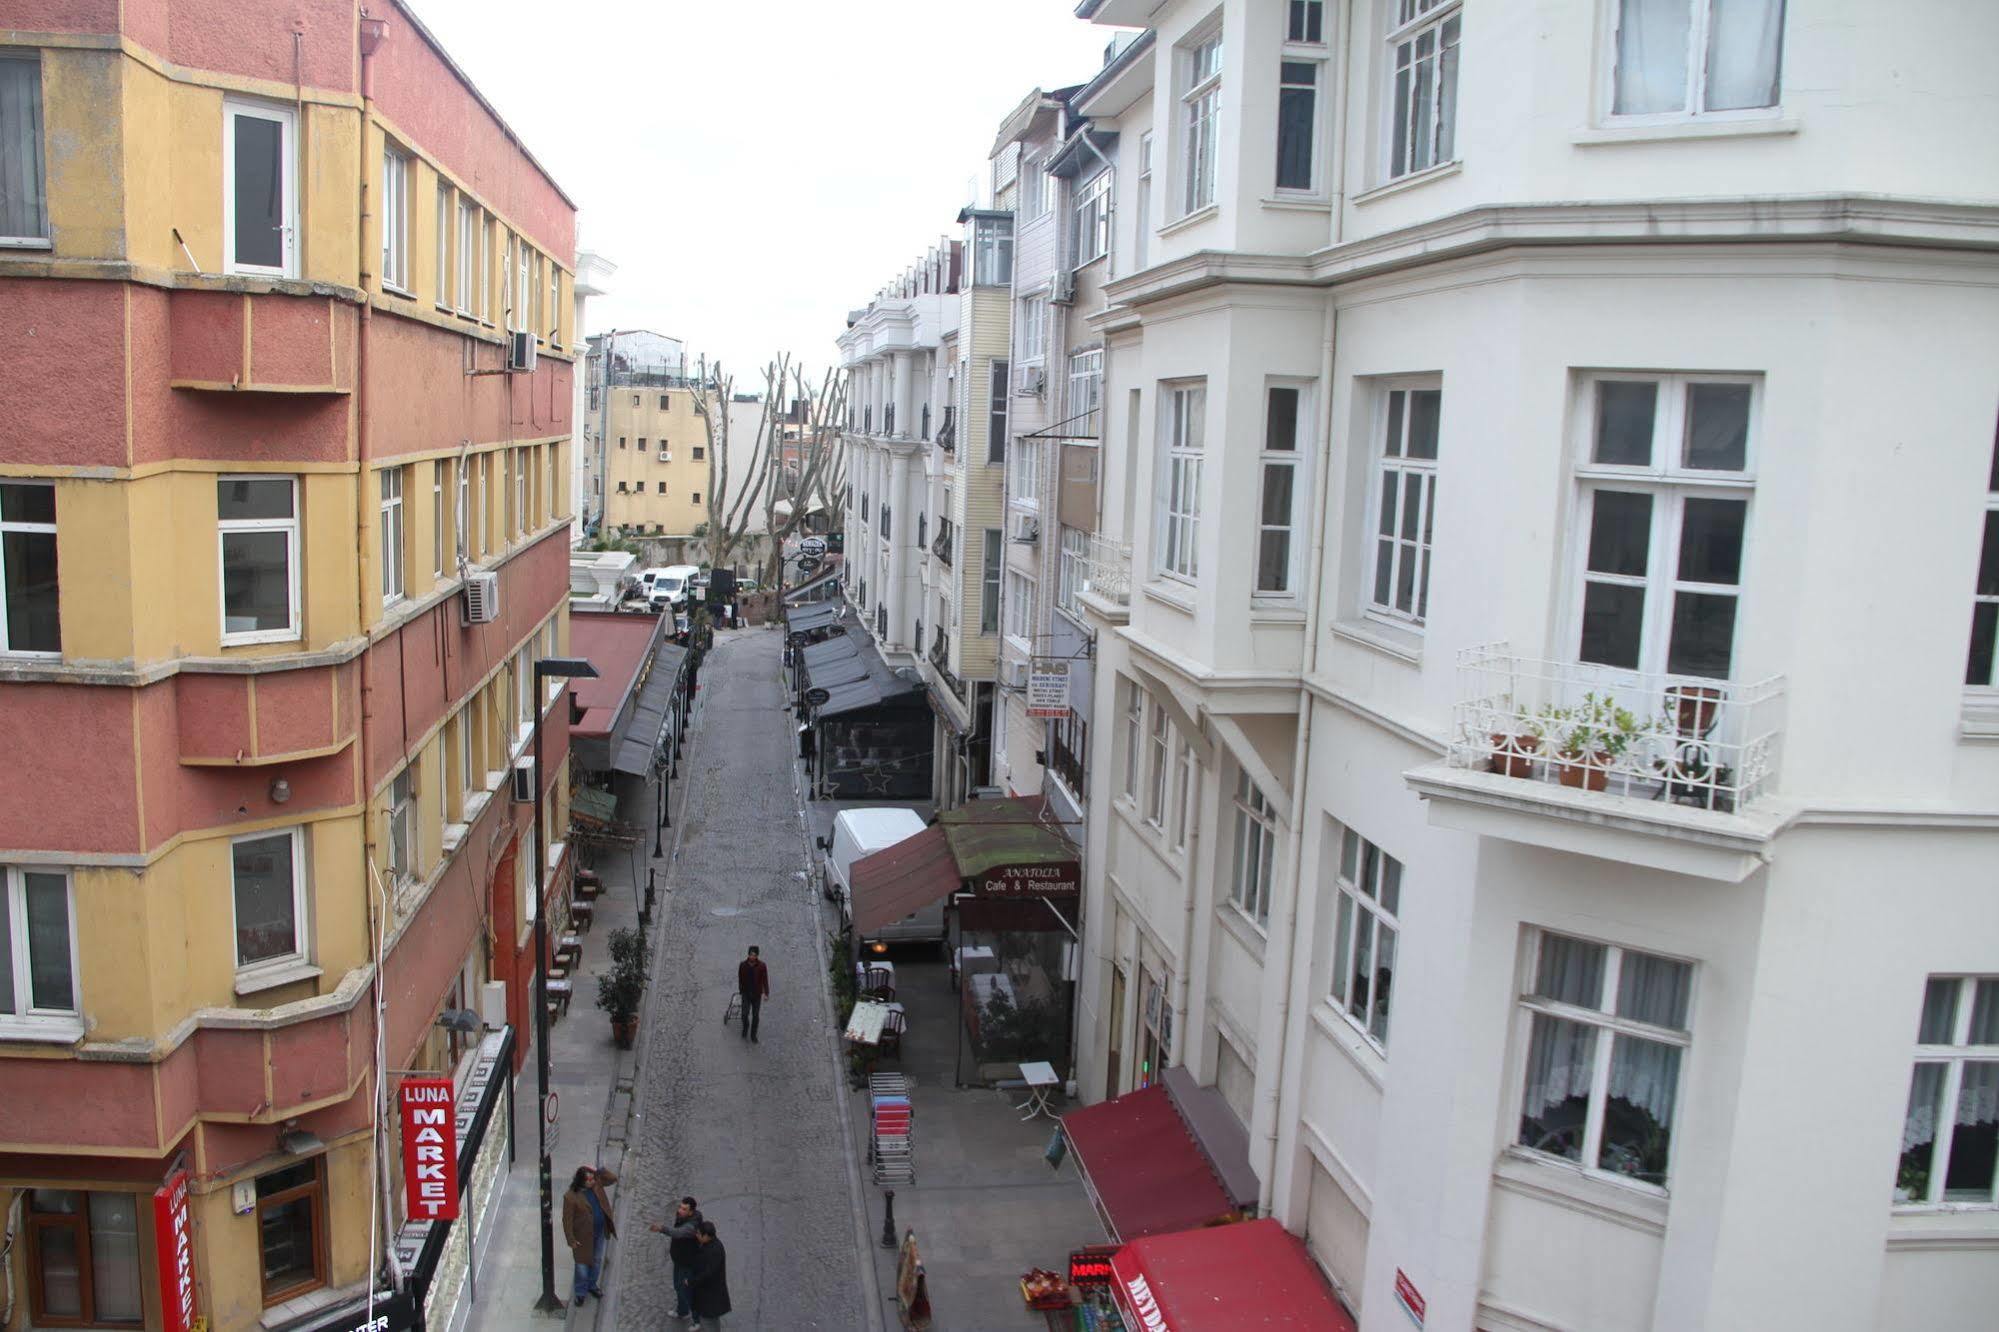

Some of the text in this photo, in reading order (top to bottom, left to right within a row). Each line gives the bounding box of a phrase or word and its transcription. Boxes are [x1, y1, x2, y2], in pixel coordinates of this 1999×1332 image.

[985, 880, 1076, 891] Cafe & Restaurant
[1002, 868, 1060, 878] ANATOLIA
[405, 1087, 450, 1103] LUNA
[413, 1108, 447, 1216] MARKET
[169, 1179, 187, 1216] LUNA
[174, 1203, 193, 1330] MARKET
